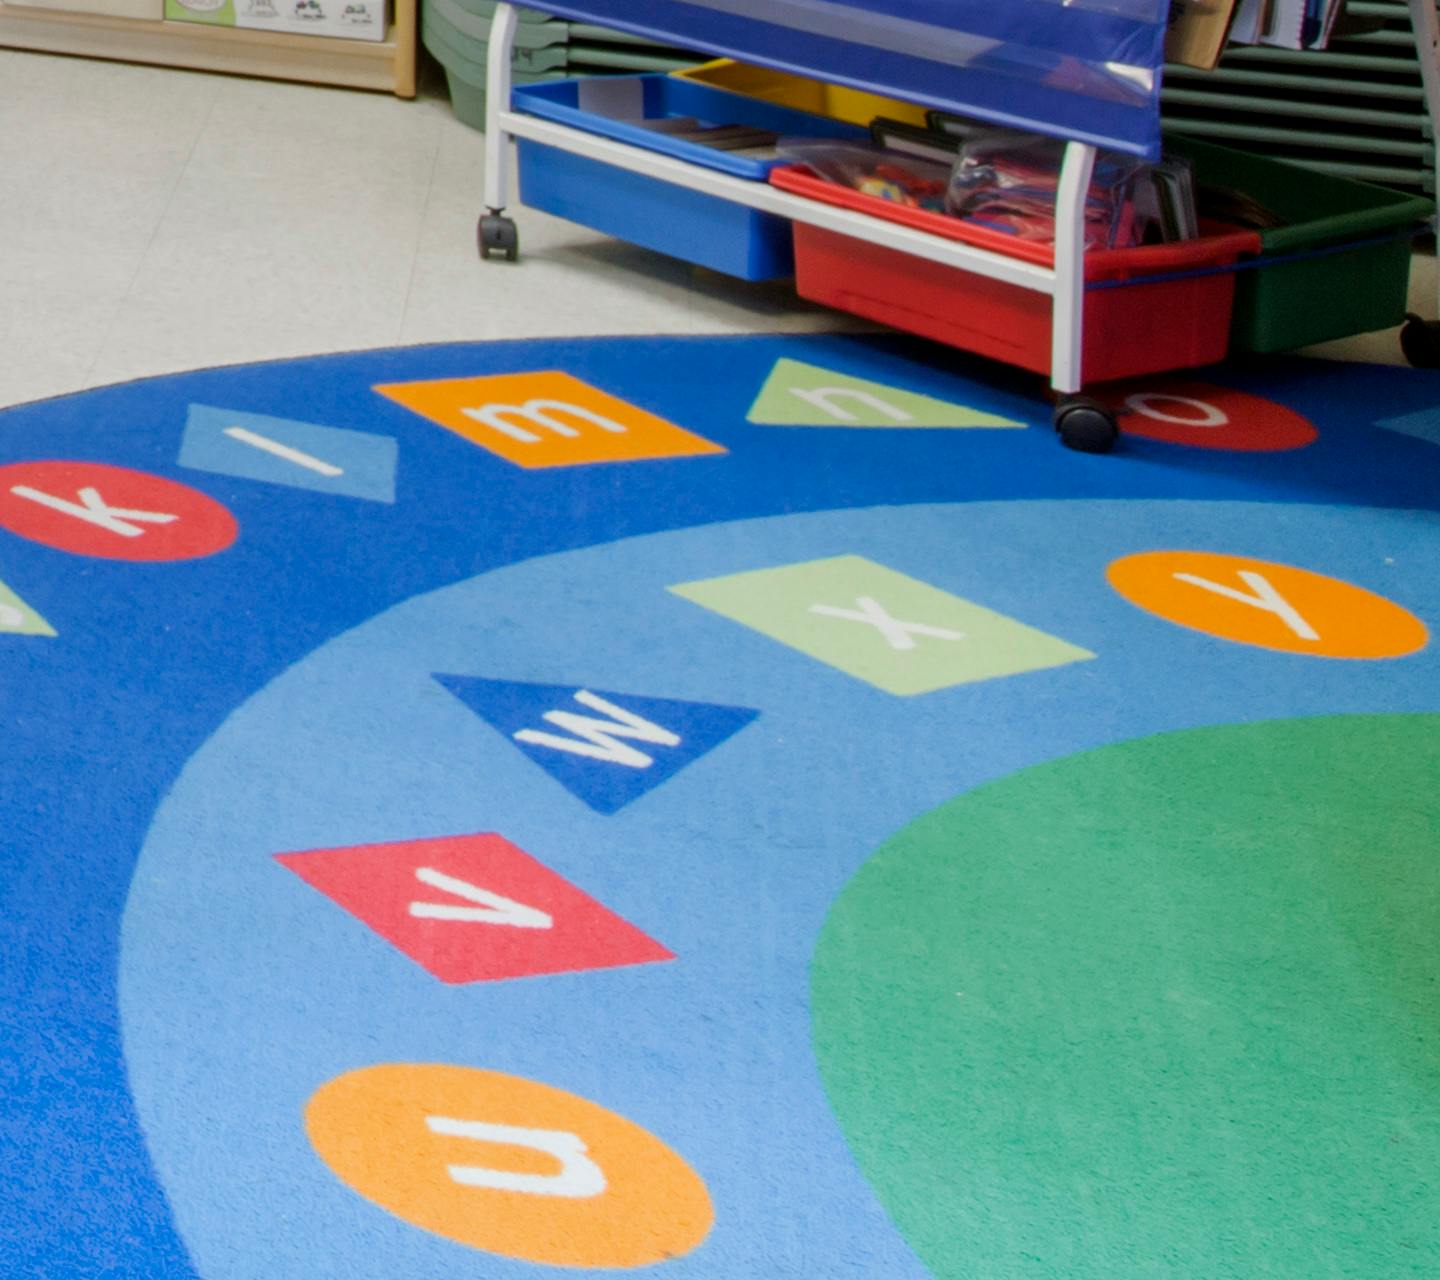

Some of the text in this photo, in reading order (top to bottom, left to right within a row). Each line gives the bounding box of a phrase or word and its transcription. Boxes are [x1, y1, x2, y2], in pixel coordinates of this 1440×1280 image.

[460, 397, 628, 442] m
[789, 382, 914, 422] n
[1124, 391, 1230, 428] o
[10, 484, 180, 538] k
[1172, 570, 1322, 641] y
[409, 866, 553, 930] v
